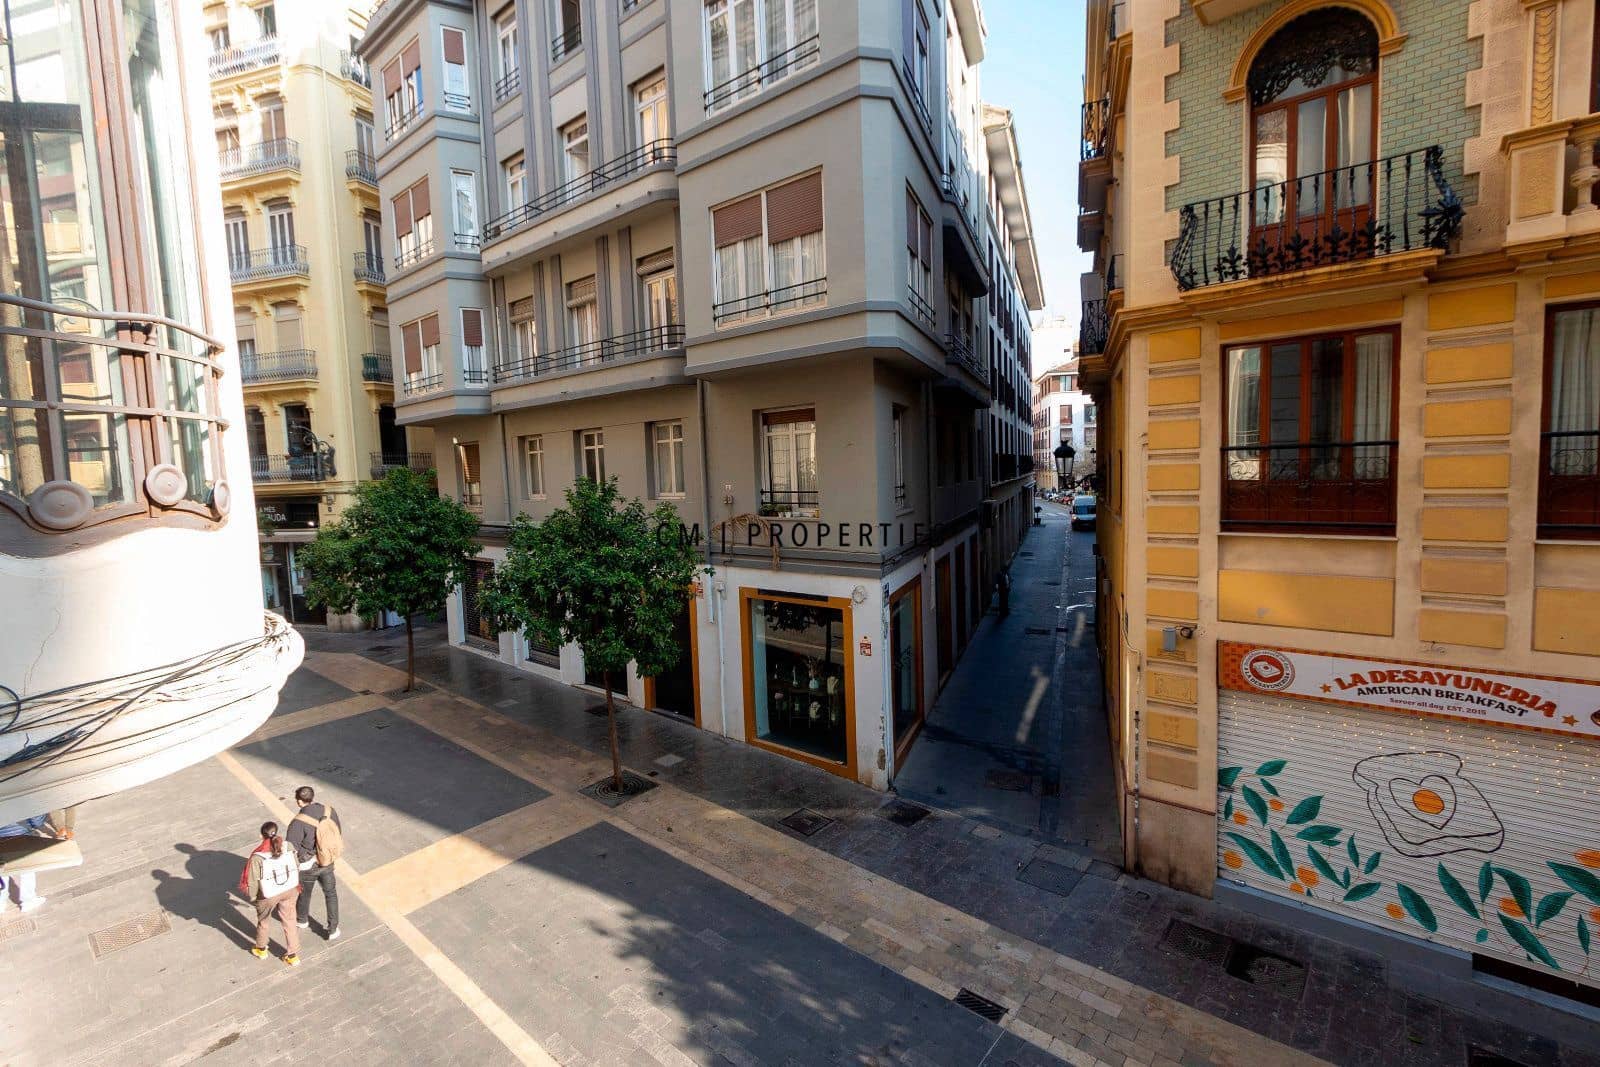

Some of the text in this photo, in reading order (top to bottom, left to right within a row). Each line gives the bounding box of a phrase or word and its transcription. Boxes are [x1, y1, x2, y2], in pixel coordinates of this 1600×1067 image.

[1334, 669, 1558, 718] LA DESAYUNERIA
[1357, 686, 1529, 717] AMERICAN BREAKFAST
